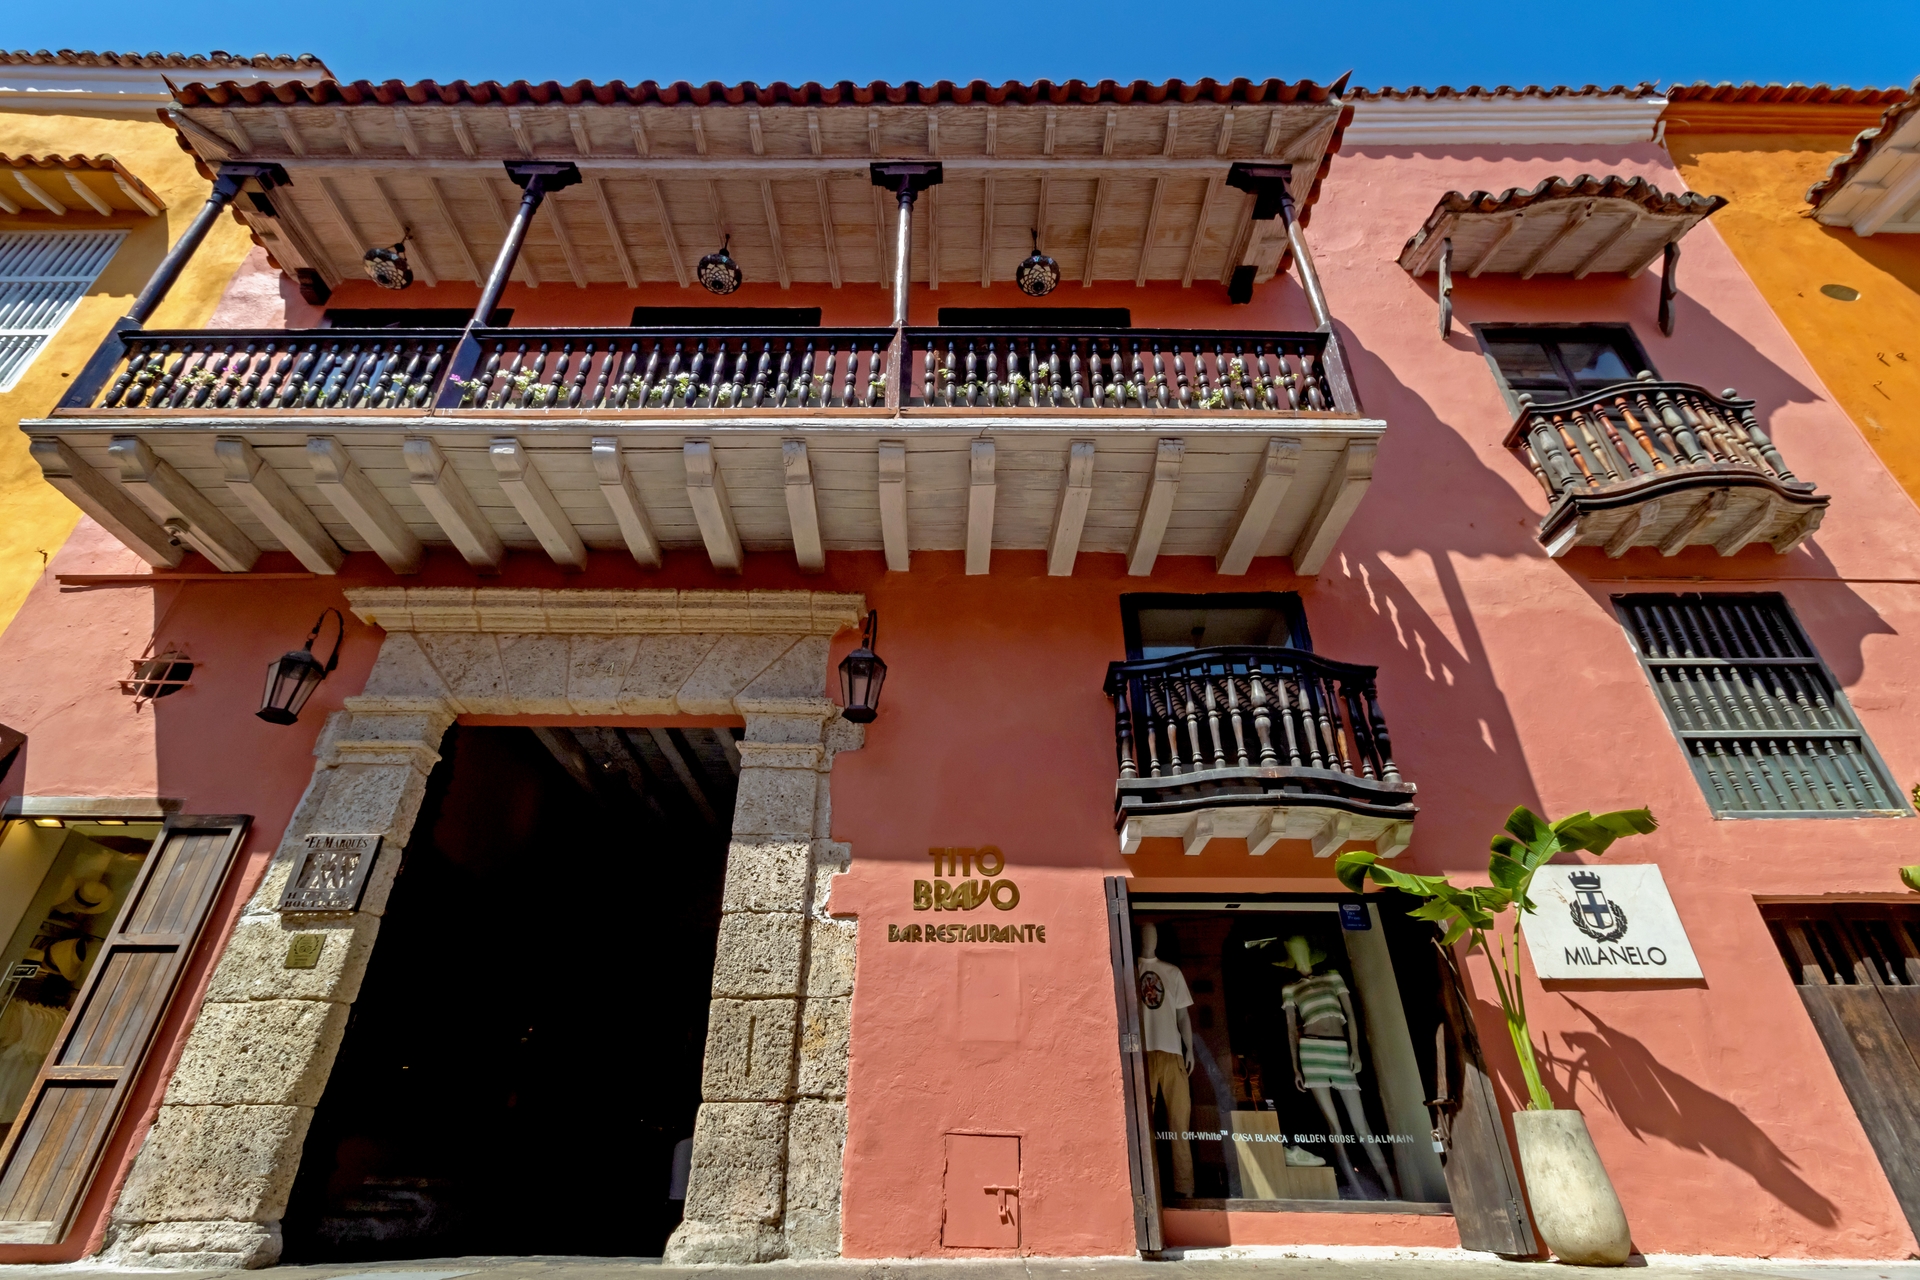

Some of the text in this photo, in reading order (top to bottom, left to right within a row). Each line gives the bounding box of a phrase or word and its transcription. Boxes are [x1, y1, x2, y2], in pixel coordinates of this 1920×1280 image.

[324, 836, 369, 850] MARQUÉS
[928, 845, 1005, 877] TITO
[913, 879, 1020, 911] BRAVO
[888, 924, 1046, 943] BAR RESTAURANTE
[1564, 946, 1667, 966] MILANELO
[1231, 1133, 1253, 1142] CASA
[1255, 1134, 1288, 1143] BLANCA
[1294, 1134, 1326, 1143] GOLDEN
[1328, 1134, 1356, 1144] GOOSE
[1368, 1135, 1414, 1143] BALMAIN
